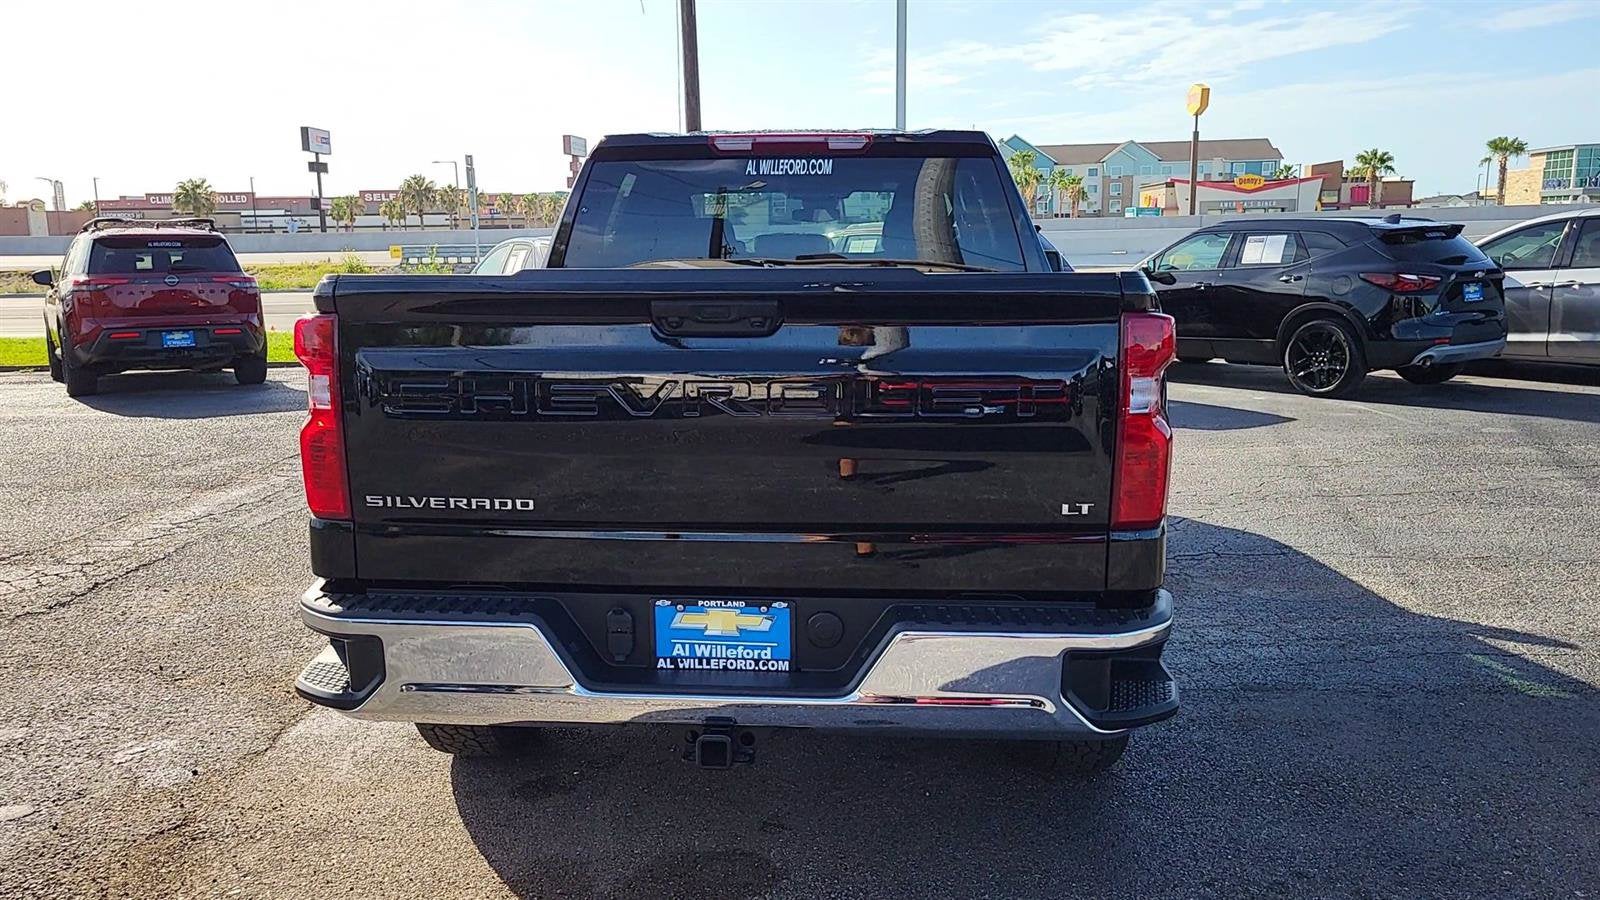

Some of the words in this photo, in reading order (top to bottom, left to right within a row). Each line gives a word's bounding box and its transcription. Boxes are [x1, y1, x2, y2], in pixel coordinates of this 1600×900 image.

[745, 159, 757, 175] AL
[759, 159, 833, 175] WILLEFORD.COM
[383, 376, 1068, 418] CHEVROLET
[365, 495, 535, 512] SILVERADO
[1061, 502, 1095, 515] LT
[698, 600, 746, 608] PORTLAND
[672, 643, 690, 657] Al
[694, 644, 772, 659] Willeford
[657, 658, 674, 669] AL
[677, 658, 790, 671] WILLEFORD.COM
